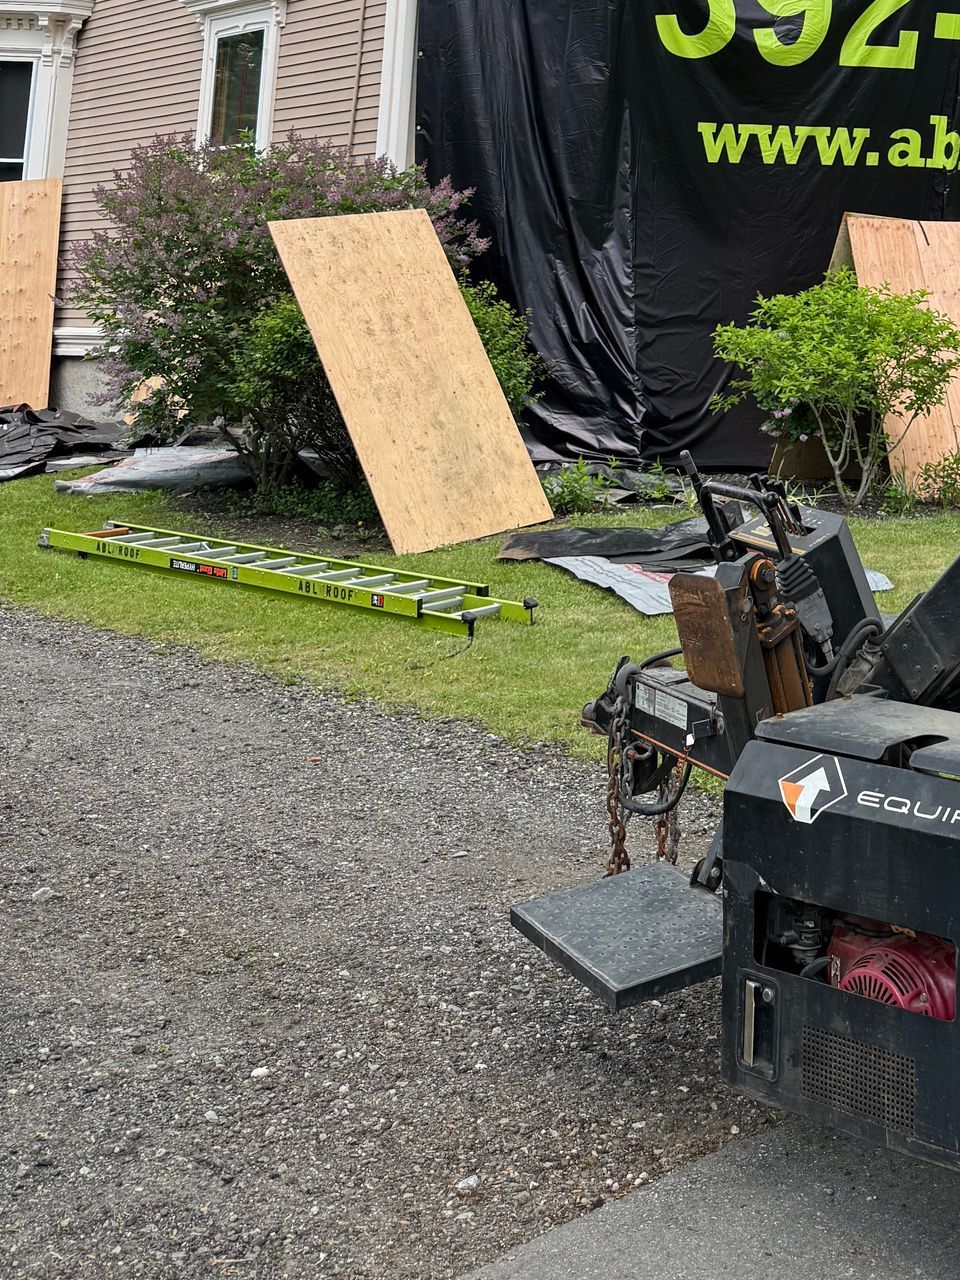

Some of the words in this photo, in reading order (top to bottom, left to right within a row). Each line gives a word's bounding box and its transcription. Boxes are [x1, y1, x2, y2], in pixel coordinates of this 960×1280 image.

[96, 541, 112, 555] ABL
[118, 545, 141, 559] ROOF
[298, 581, 318, 595] ABL
[325, 584, 354, 601] ROOF
